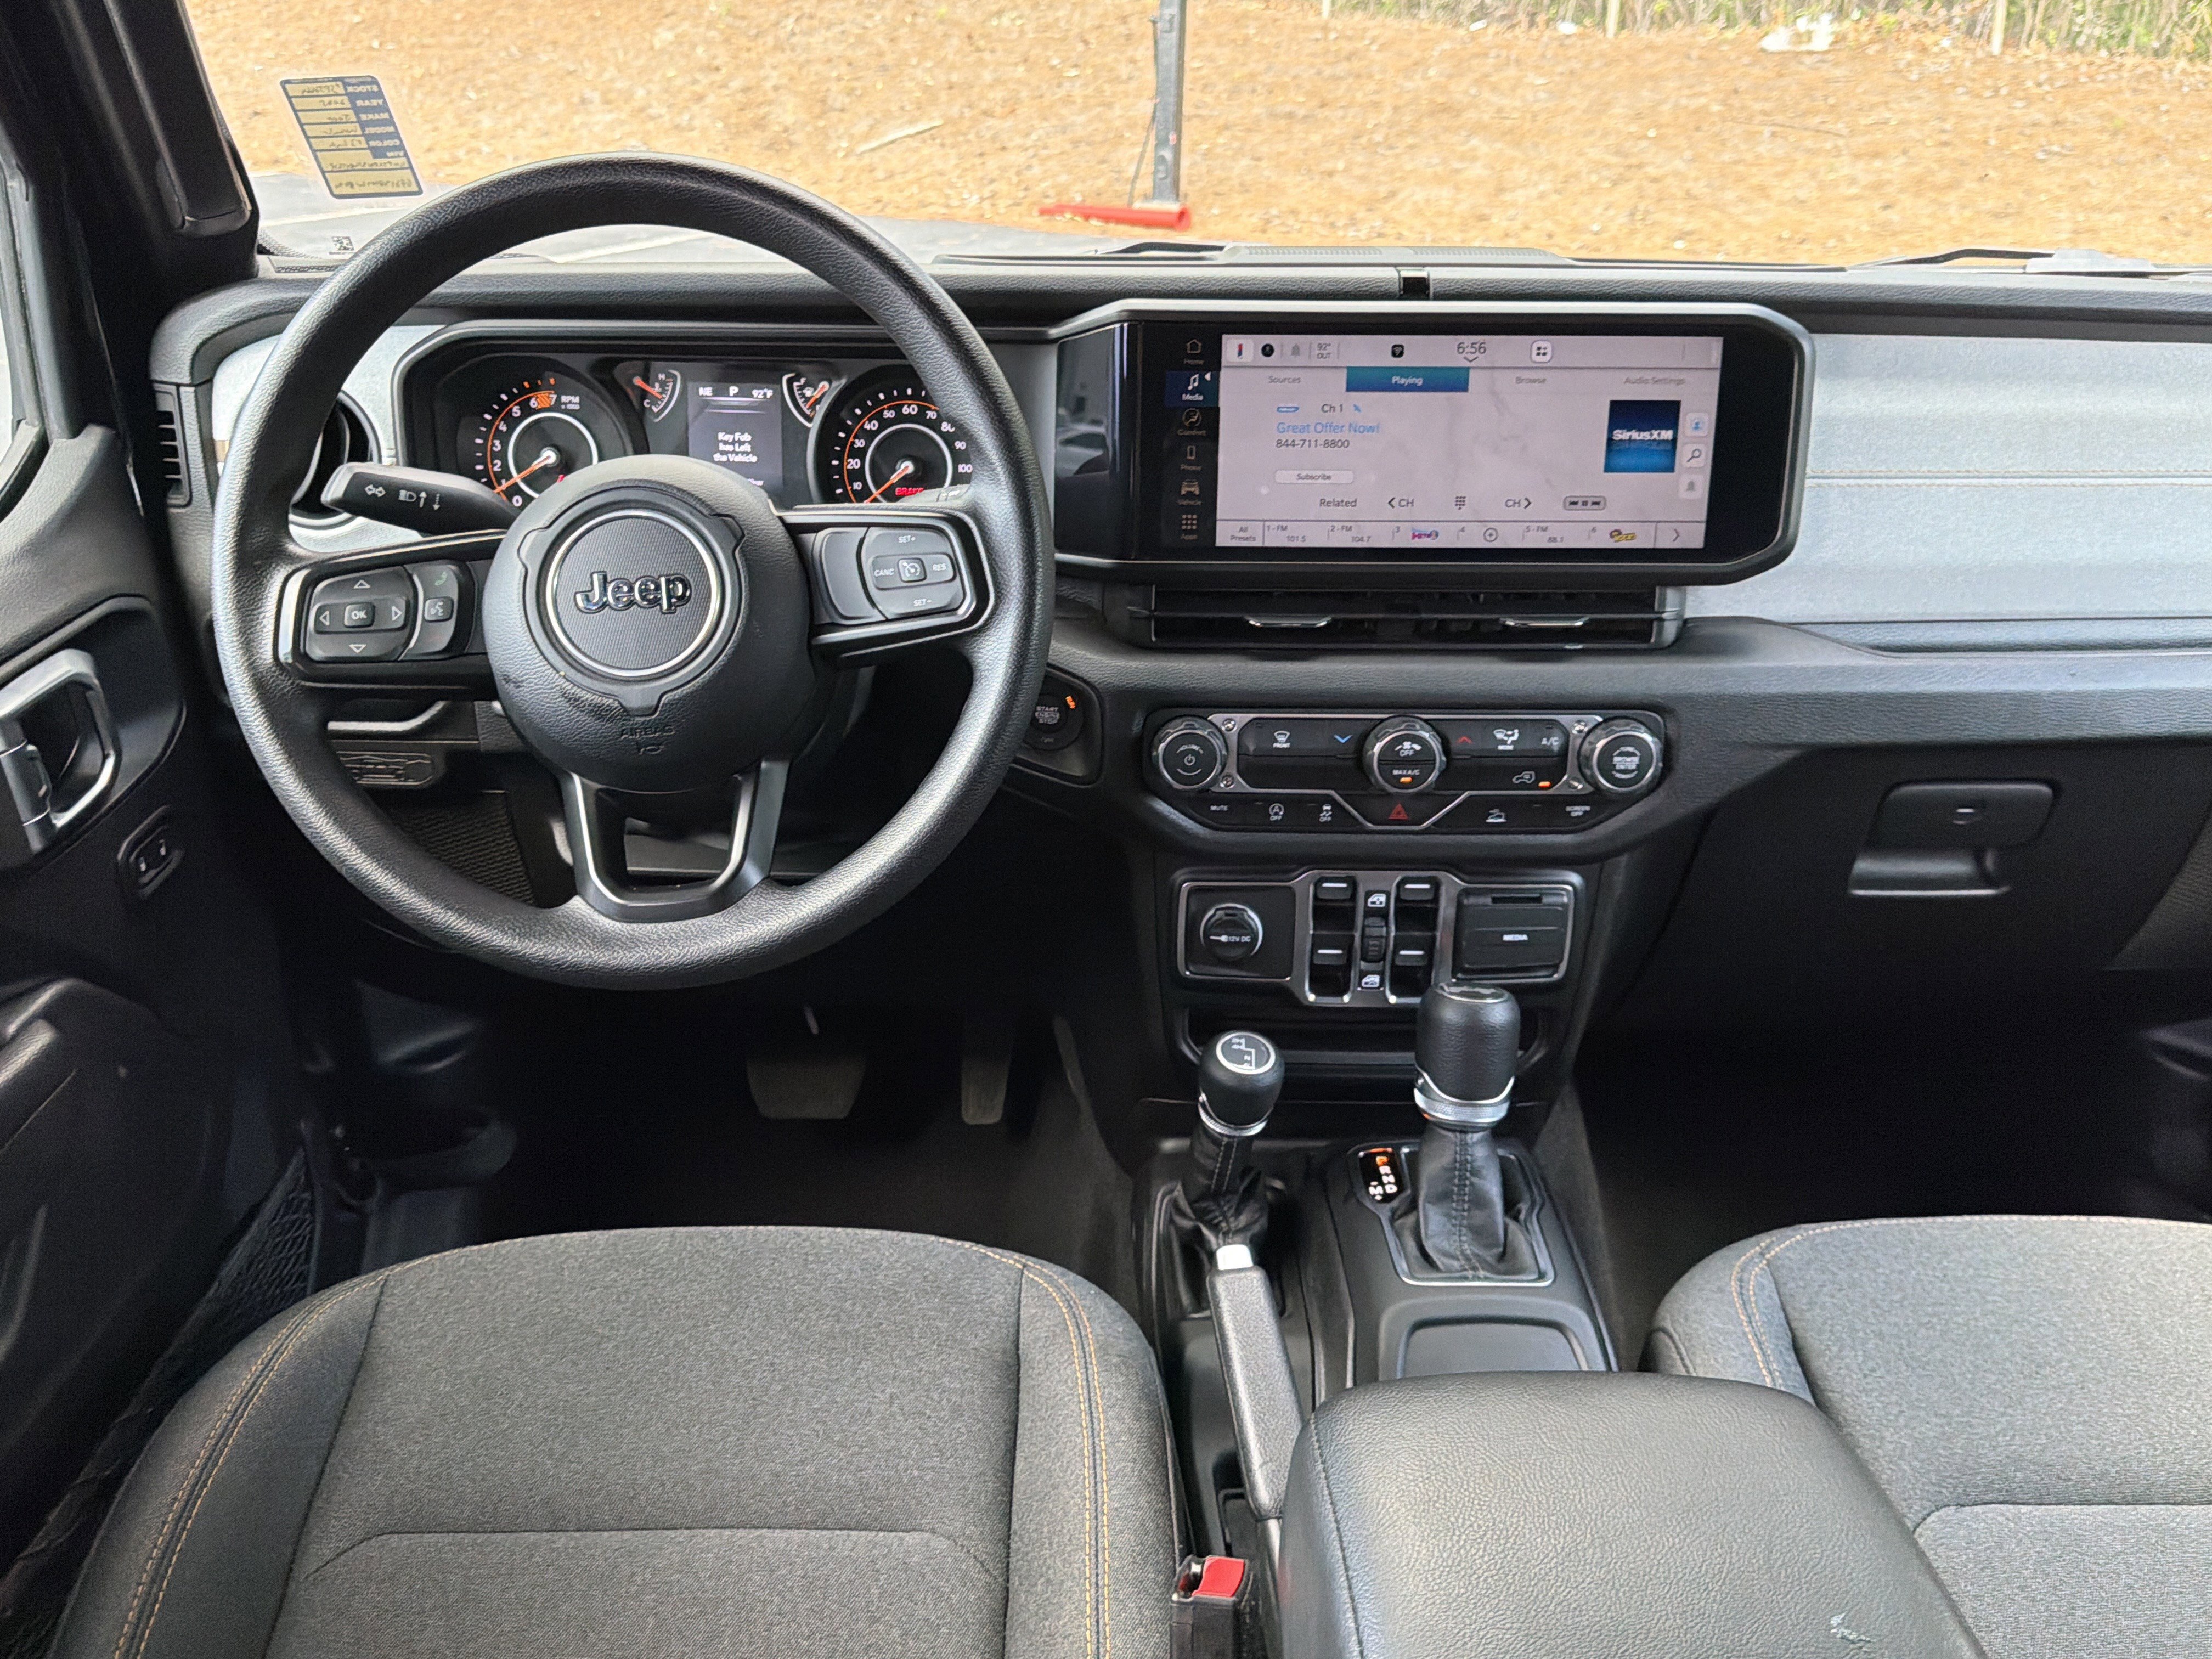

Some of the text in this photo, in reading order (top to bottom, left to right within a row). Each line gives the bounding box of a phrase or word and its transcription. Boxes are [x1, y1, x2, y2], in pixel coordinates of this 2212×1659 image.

[1457, 341, 1487, 354] 6:56
[1268, 375, 1301, 385] Sources
[1391, 375, 1424, 387] Playing
[729, 386, 739, 397] P
[529, 397, 539, 409] 6
[549, 394, 557, 406] 7
[561, 395, 580, 403] RPM
[511, 405, 521, 417] 5
[902, 404, 918, 415] 60
[1321, 404, 1344, 413] Ch 1
[883, 410, 895, 419] 50
[925, 410, 938, 420] 70
[498, 421, 508, 432] 4
[864, 420, 879, 431] 40
[1276, 421, 1380, 434] Great Offer Now!
[718, 432, 752, 442] Key Fob
[1612, 428, 1674, 441] SiriusXM
[492, 439, 502, 452] 3
[735, 442, 752, 452] Left
[853, 439, 866, 448] 30
[954, 441, 967, 450] 90
[1276, 439, 1351, 449] 844-711-8800
[728, 453, 758, 462] Vehicle
[493, 460, 502, 472] 2
[847, 459, 861, 469] 20
[958, 464, 973, 473] 100
[1296, 472, 1332, 481] Subscribe
[853, 481, 862, 490] 10
[512, 495, 523, 507] 0
[1319, 498, 1357, 508] Related
[1398, 498, 1415, 508] CH
[1505, 498, 1521, 508] CH
[933, 563, 947, 571] RES
[874, 568, 895, 577] CANC
[574, 571, 692, 615] Jeep
[351, 611, 368, 620] OK
[1541, 736, 1560, 746] A/C
[1382, 1175, 1396, 1184] N
[1385, 1184, 1398, 1194] D
